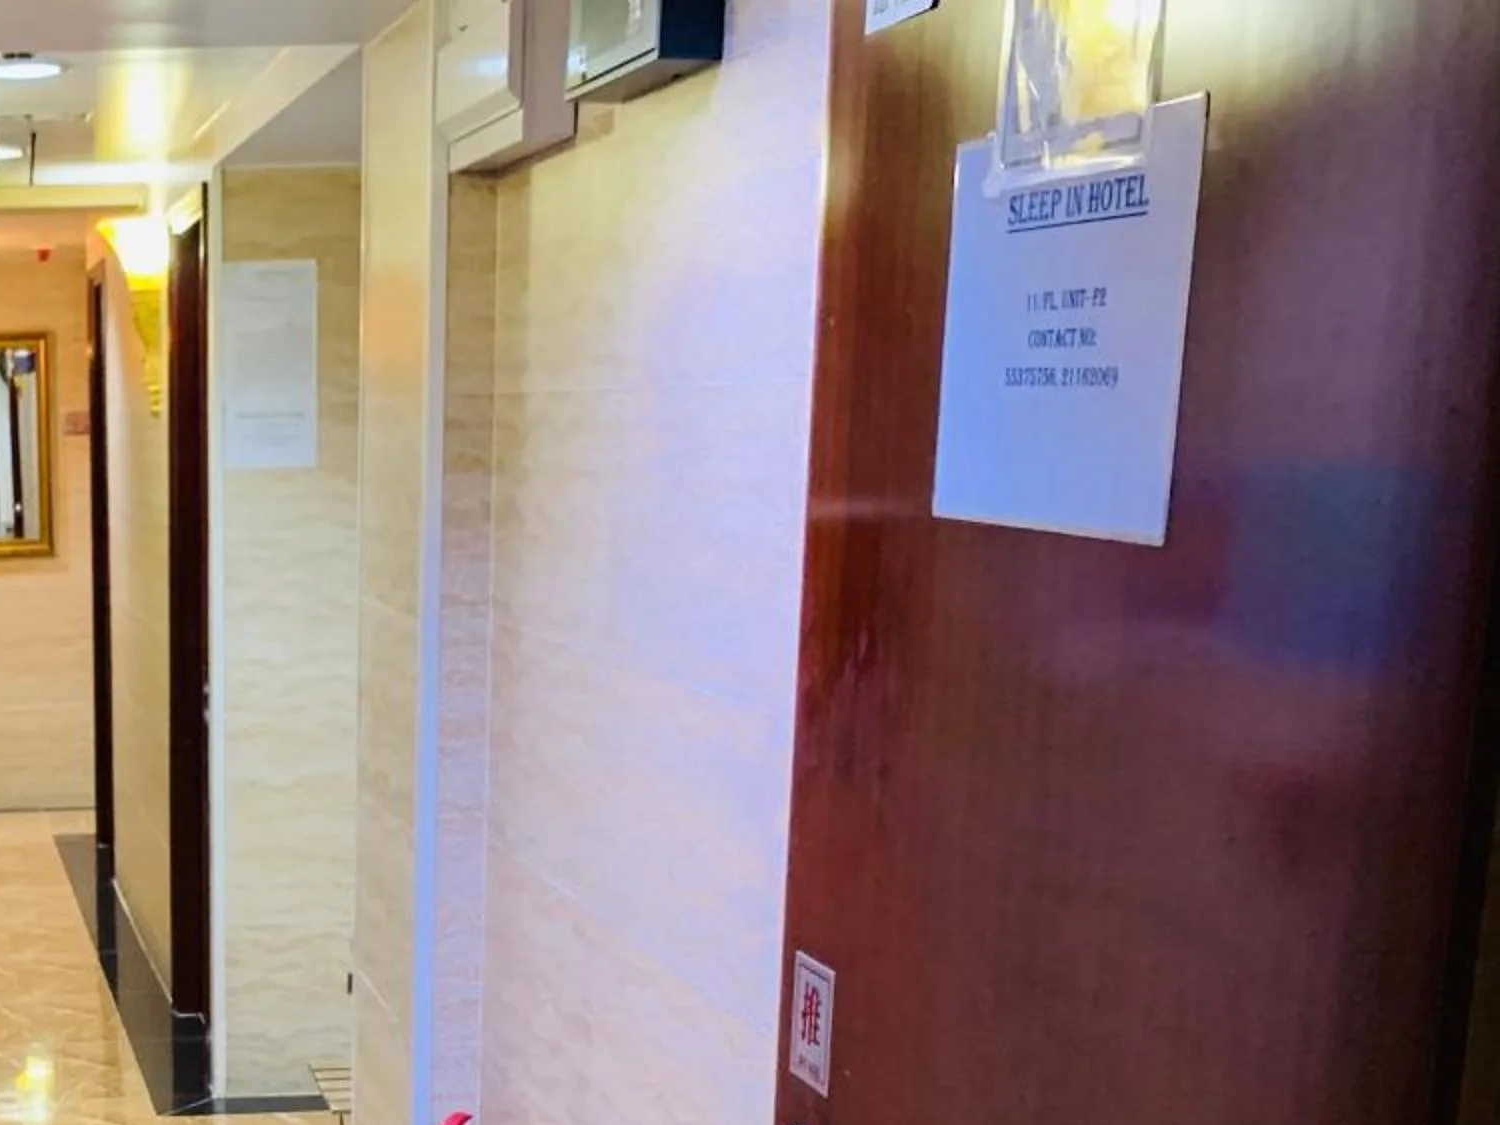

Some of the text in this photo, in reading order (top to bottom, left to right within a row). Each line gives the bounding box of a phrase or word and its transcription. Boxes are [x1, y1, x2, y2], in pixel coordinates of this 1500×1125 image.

[1007, 174, 1150, 226] SLEEP IN HOTEL
[801, 980, 823, 1047] 推
